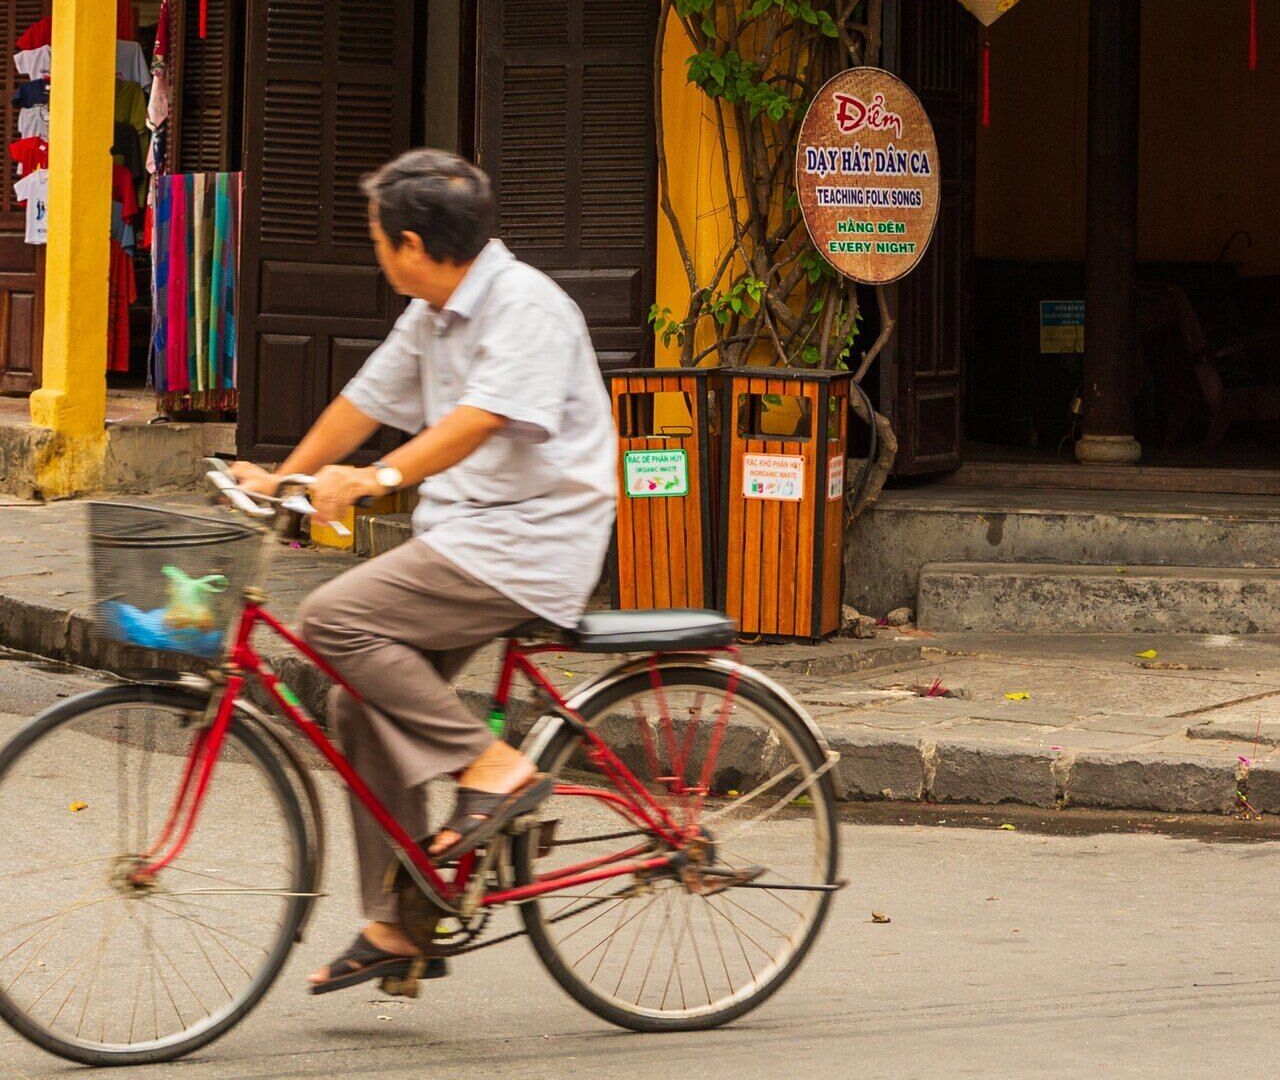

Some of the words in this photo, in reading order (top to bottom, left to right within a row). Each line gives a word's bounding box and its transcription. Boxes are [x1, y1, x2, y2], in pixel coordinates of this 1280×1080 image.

[835, 94, 902, 138] Điểm
[807, 149, 837, 175] DẠY
[842, 145, 871, 172] HÁT
[875, 146, 907, 174] DÂN
[910, 153, 931, 174] CA
[818, 189, 864, 205] TEACHING
[866, 190, 889, 205] FOLK
[892, 191, 921, 206] SONGS
[878, 221, 905, 233] ĐÊM
[829, 242, 871, 253] EVERY
[876, 243, 915, 253] NIGHT
[750, 470, 778, 478] INORGANIC
